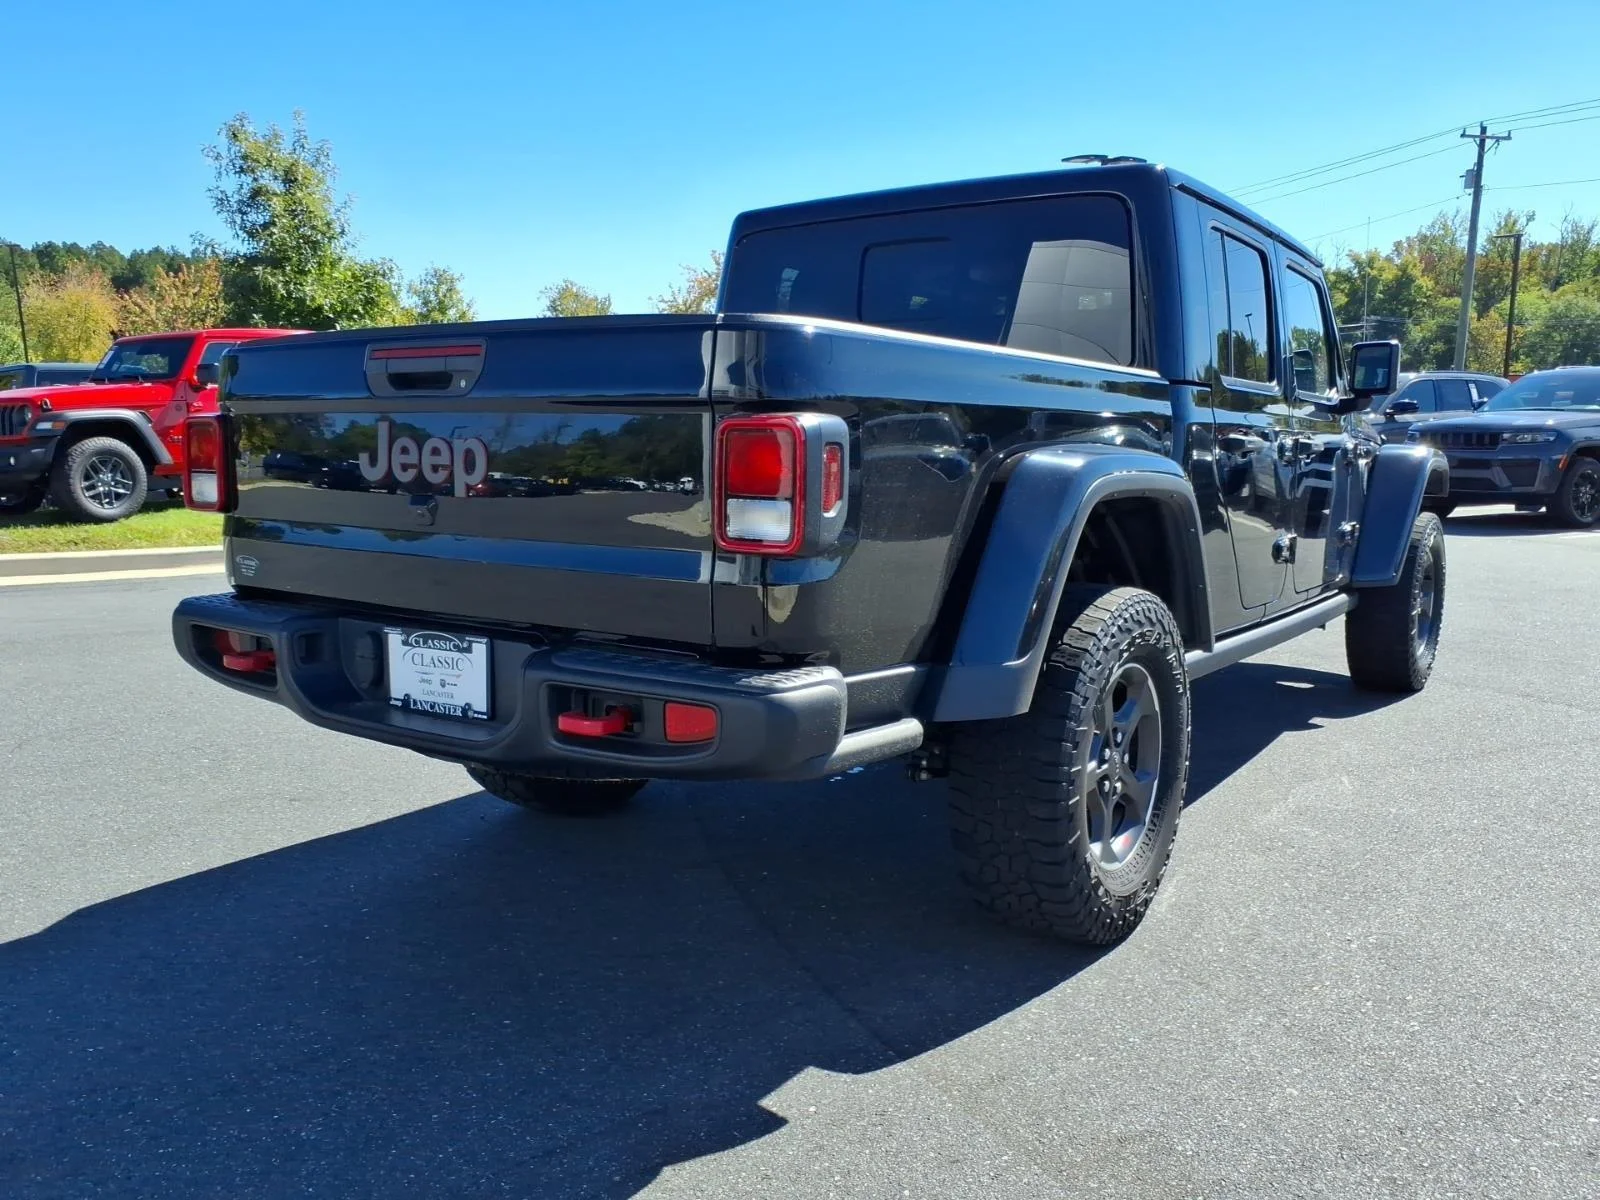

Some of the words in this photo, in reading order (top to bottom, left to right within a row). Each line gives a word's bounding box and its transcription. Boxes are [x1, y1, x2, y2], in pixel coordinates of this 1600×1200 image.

[358, 420, 488, 498] Jeep
[412, 637, 459, 652] CLASSIC
[411, 652, 465, 672] CLASSIC
[422, 688, 455, 700] LANCASTER
[410, 699, 462, 716] LANCASTER
